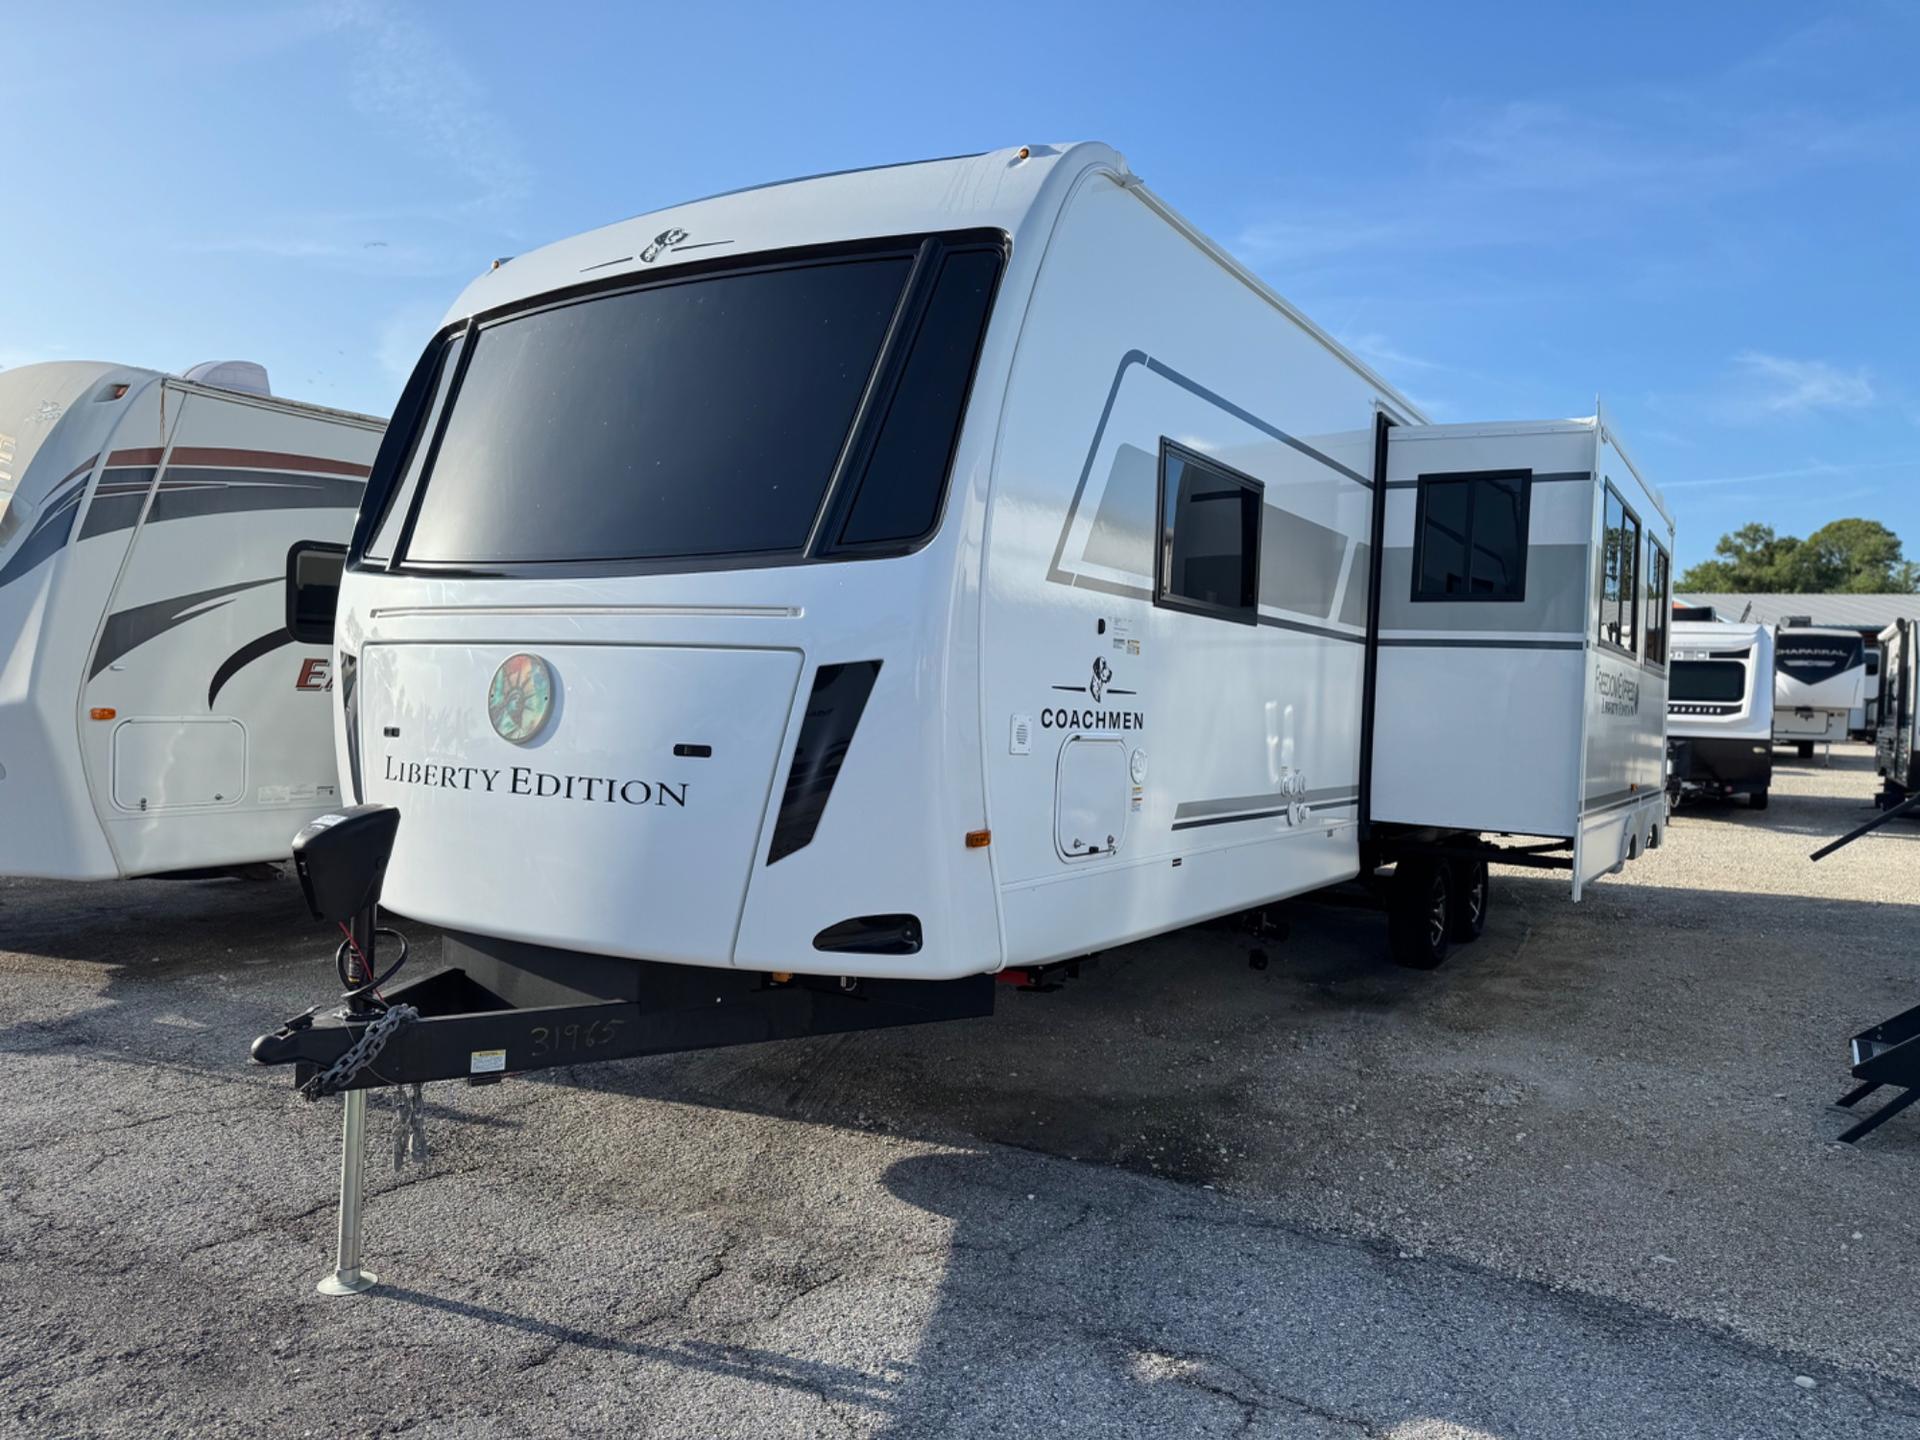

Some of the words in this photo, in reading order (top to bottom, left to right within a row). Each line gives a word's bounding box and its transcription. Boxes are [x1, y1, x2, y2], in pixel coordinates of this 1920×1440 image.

[1041, 708, 1144, 730] COACHMEN
[385, 755, 501, 792] LIBERTY
[507, 766, 691, 807] EDITION
[530, 1018, 625, 1057] 31965
